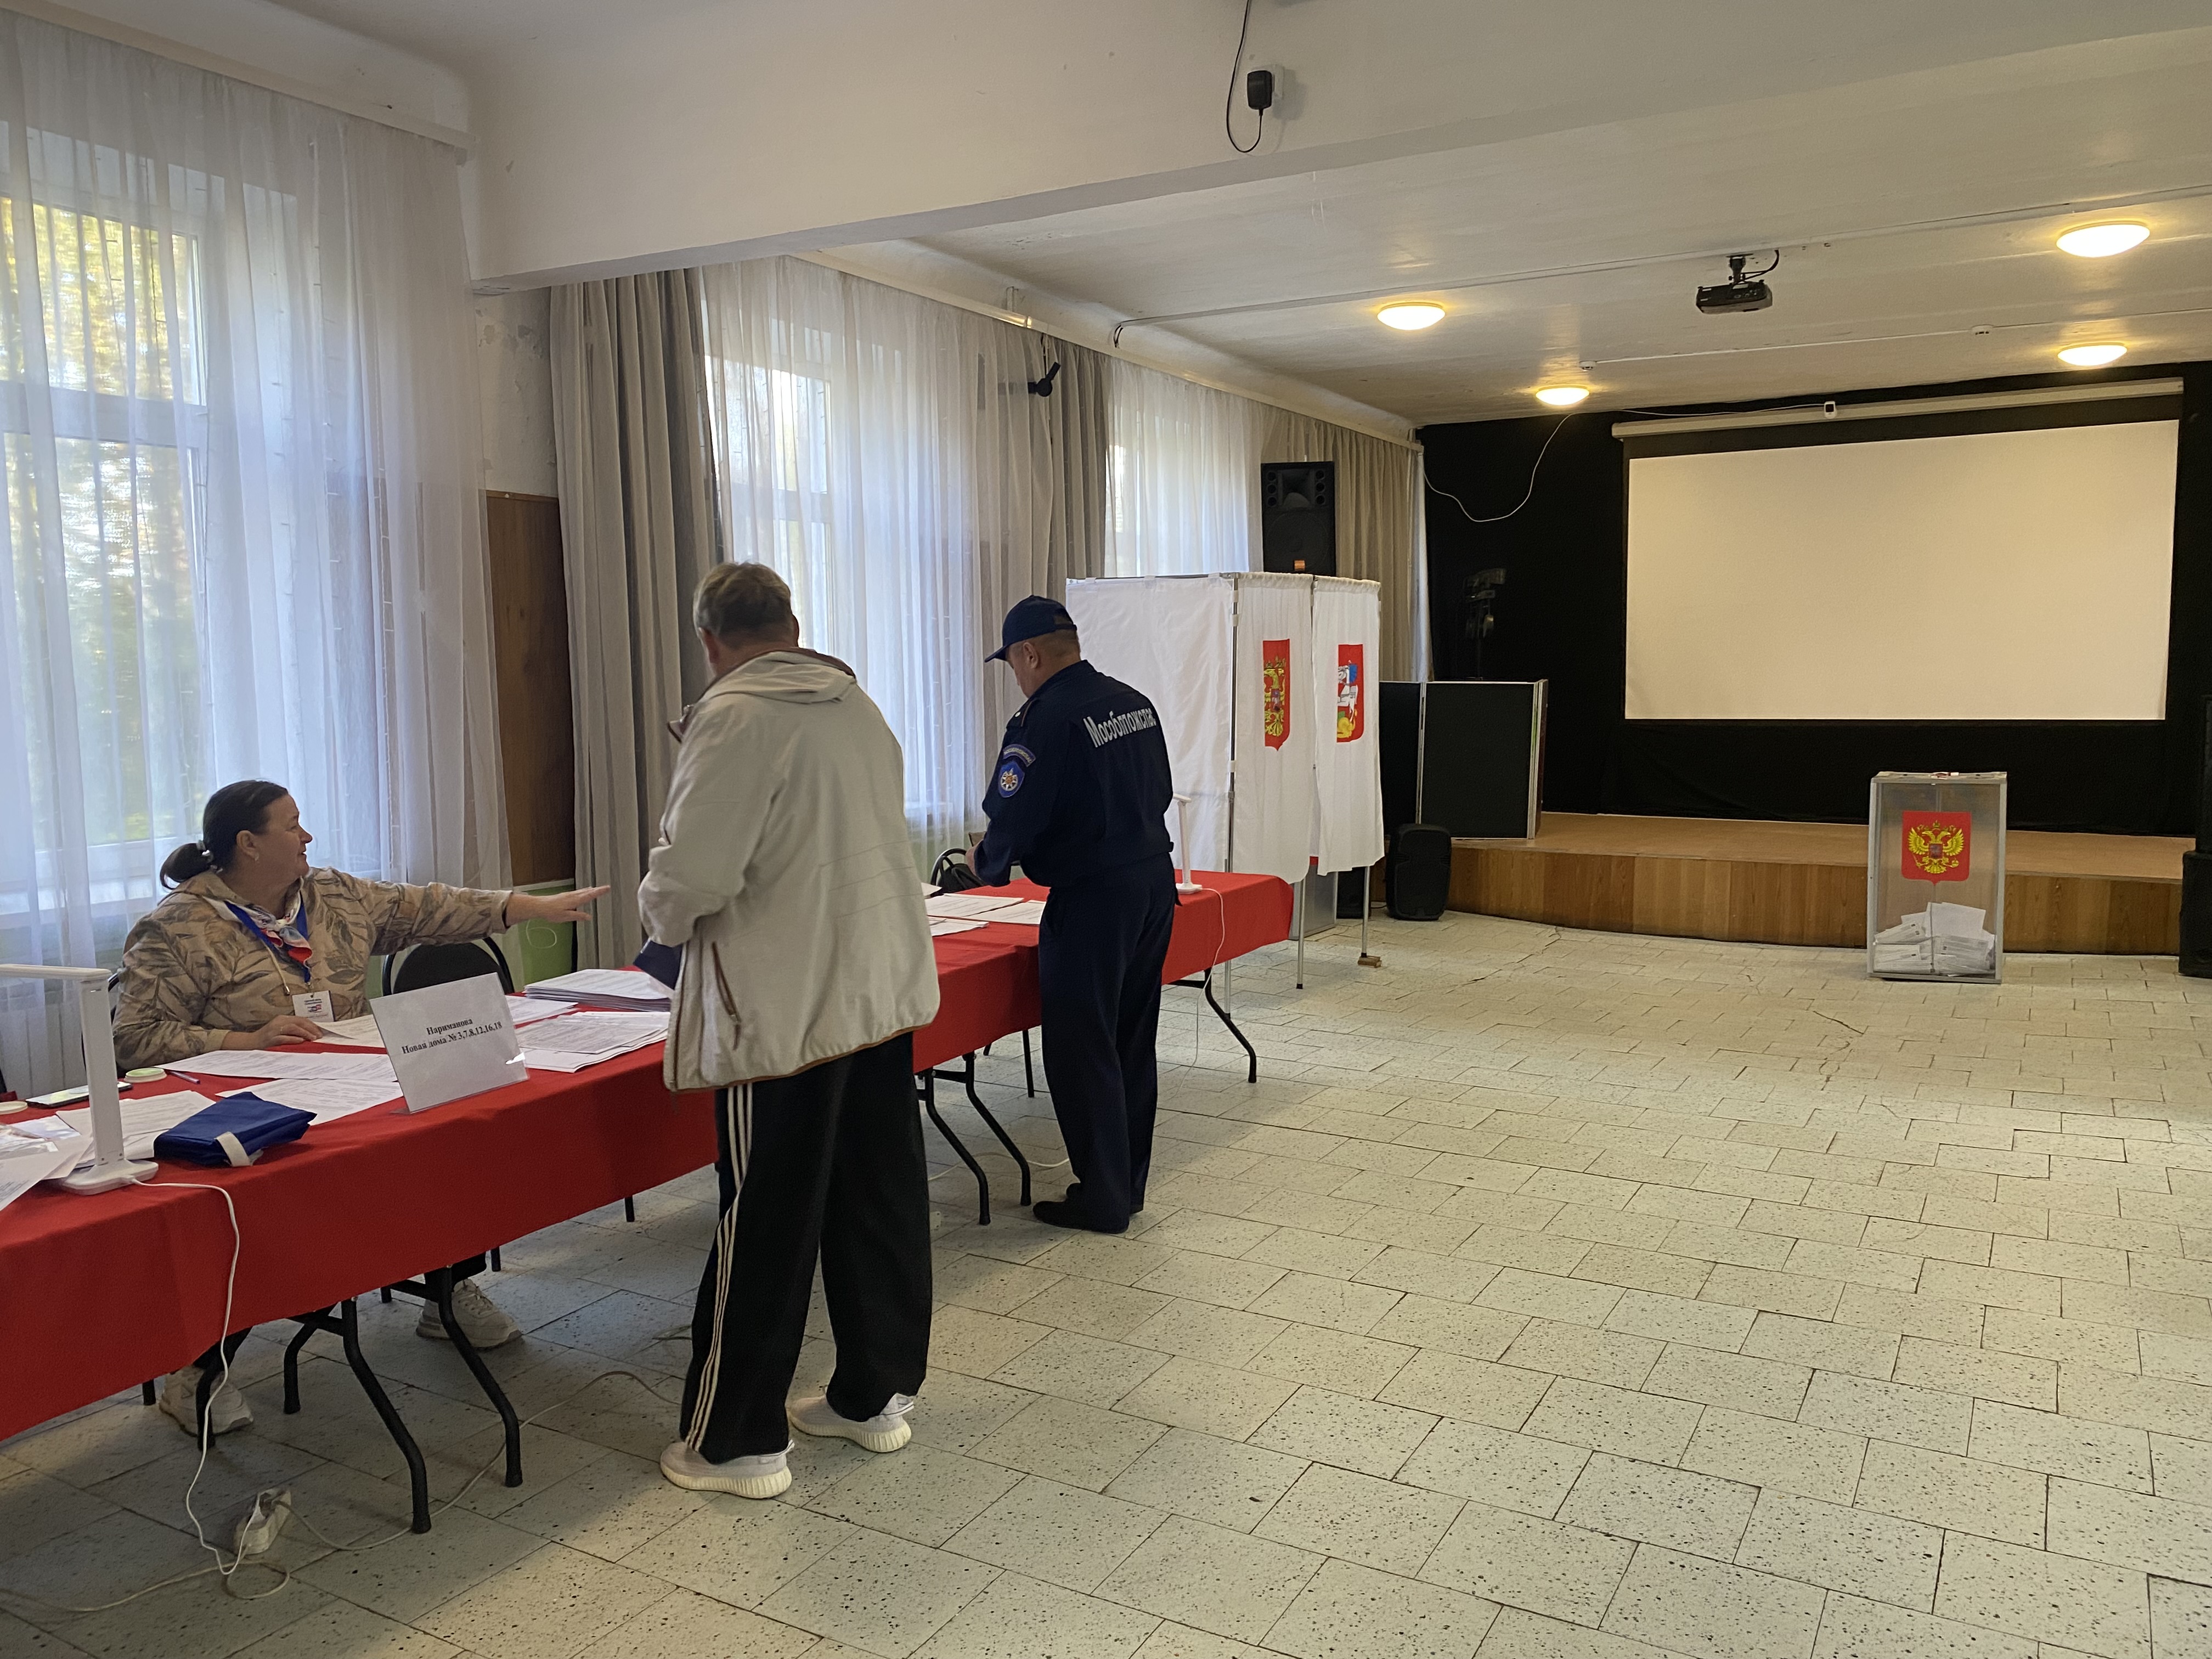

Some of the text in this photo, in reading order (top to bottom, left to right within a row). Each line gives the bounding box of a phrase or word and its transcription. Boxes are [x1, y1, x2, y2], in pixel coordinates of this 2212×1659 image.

[426, 1018, 473, 1035] Нариманова
[402, 1042, 427, 1054] Новая
[428, 1037, 447, 1048] дома
[448, 1033, 457, 1042] №
